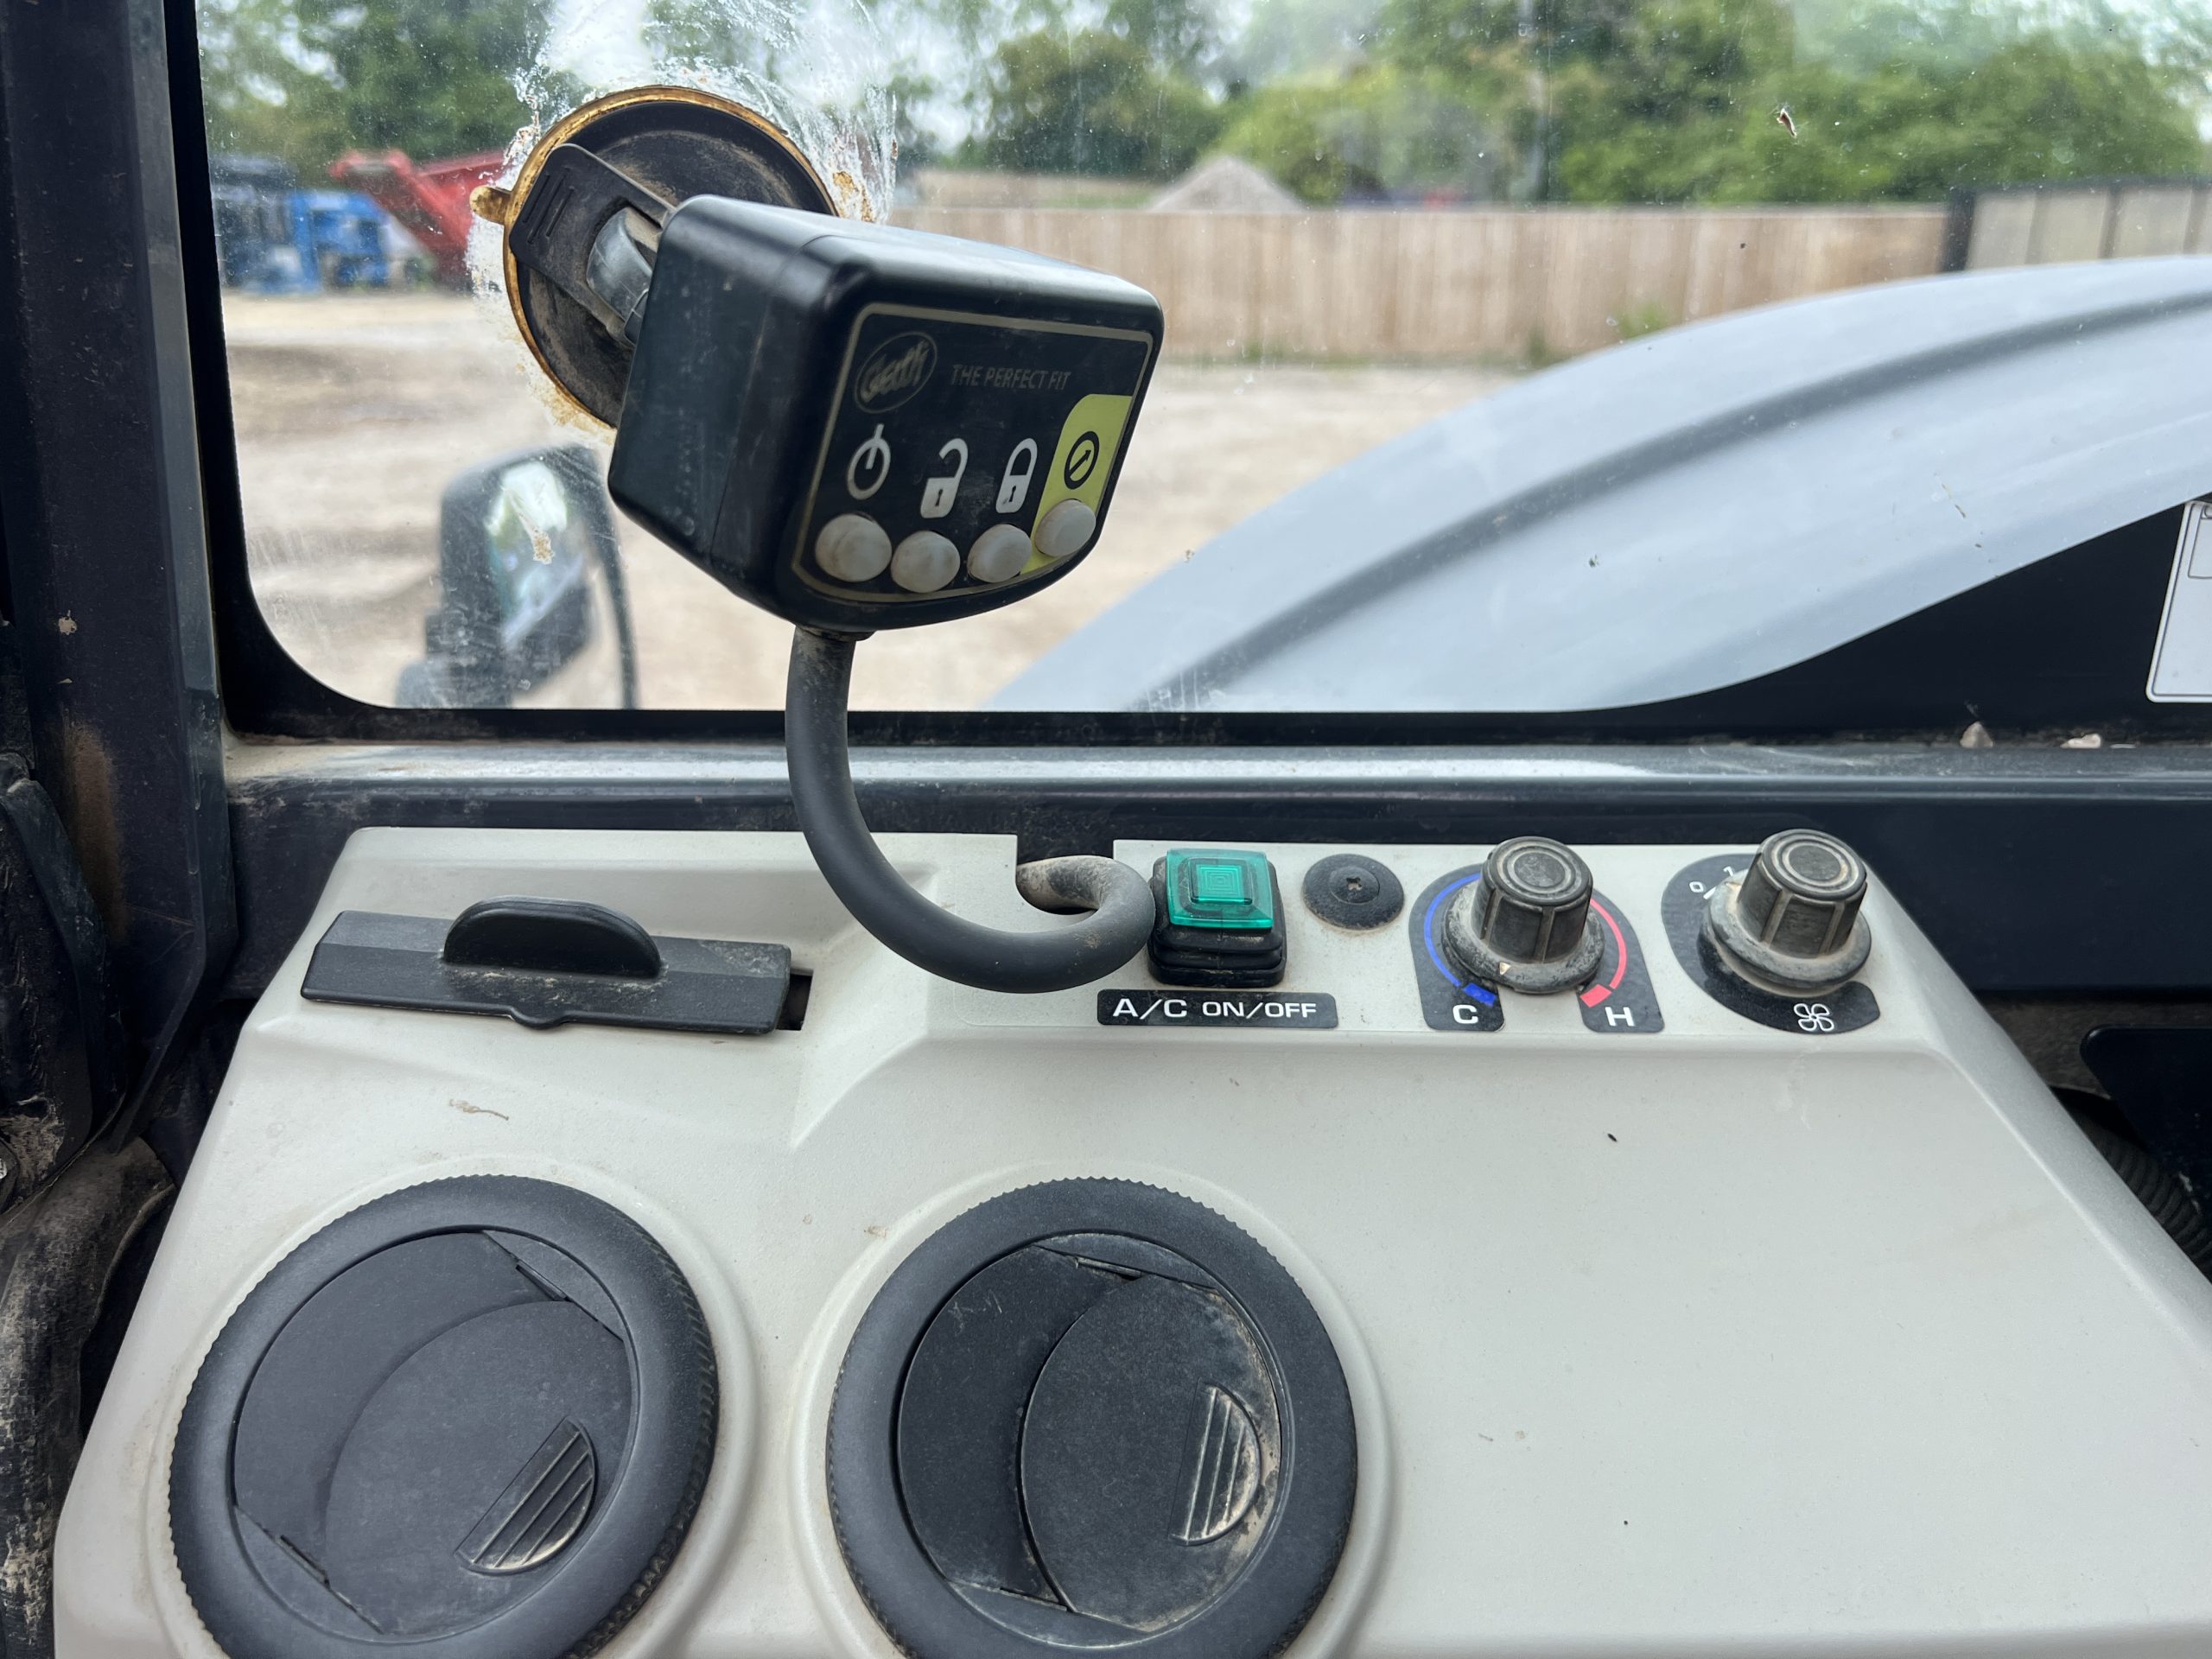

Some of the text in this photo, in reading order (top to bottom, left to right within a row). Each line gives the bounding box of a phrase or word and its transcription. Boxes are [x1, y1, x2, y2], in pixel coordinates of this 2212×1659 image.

[950, 364, 1071, 391] THE PERFECT FIT
[1112, 998, 1318, 1020] A/C ON/OFF
[1452, 1005, 1478, 1025] C
[1605, 1007, 1635, 1027] H
